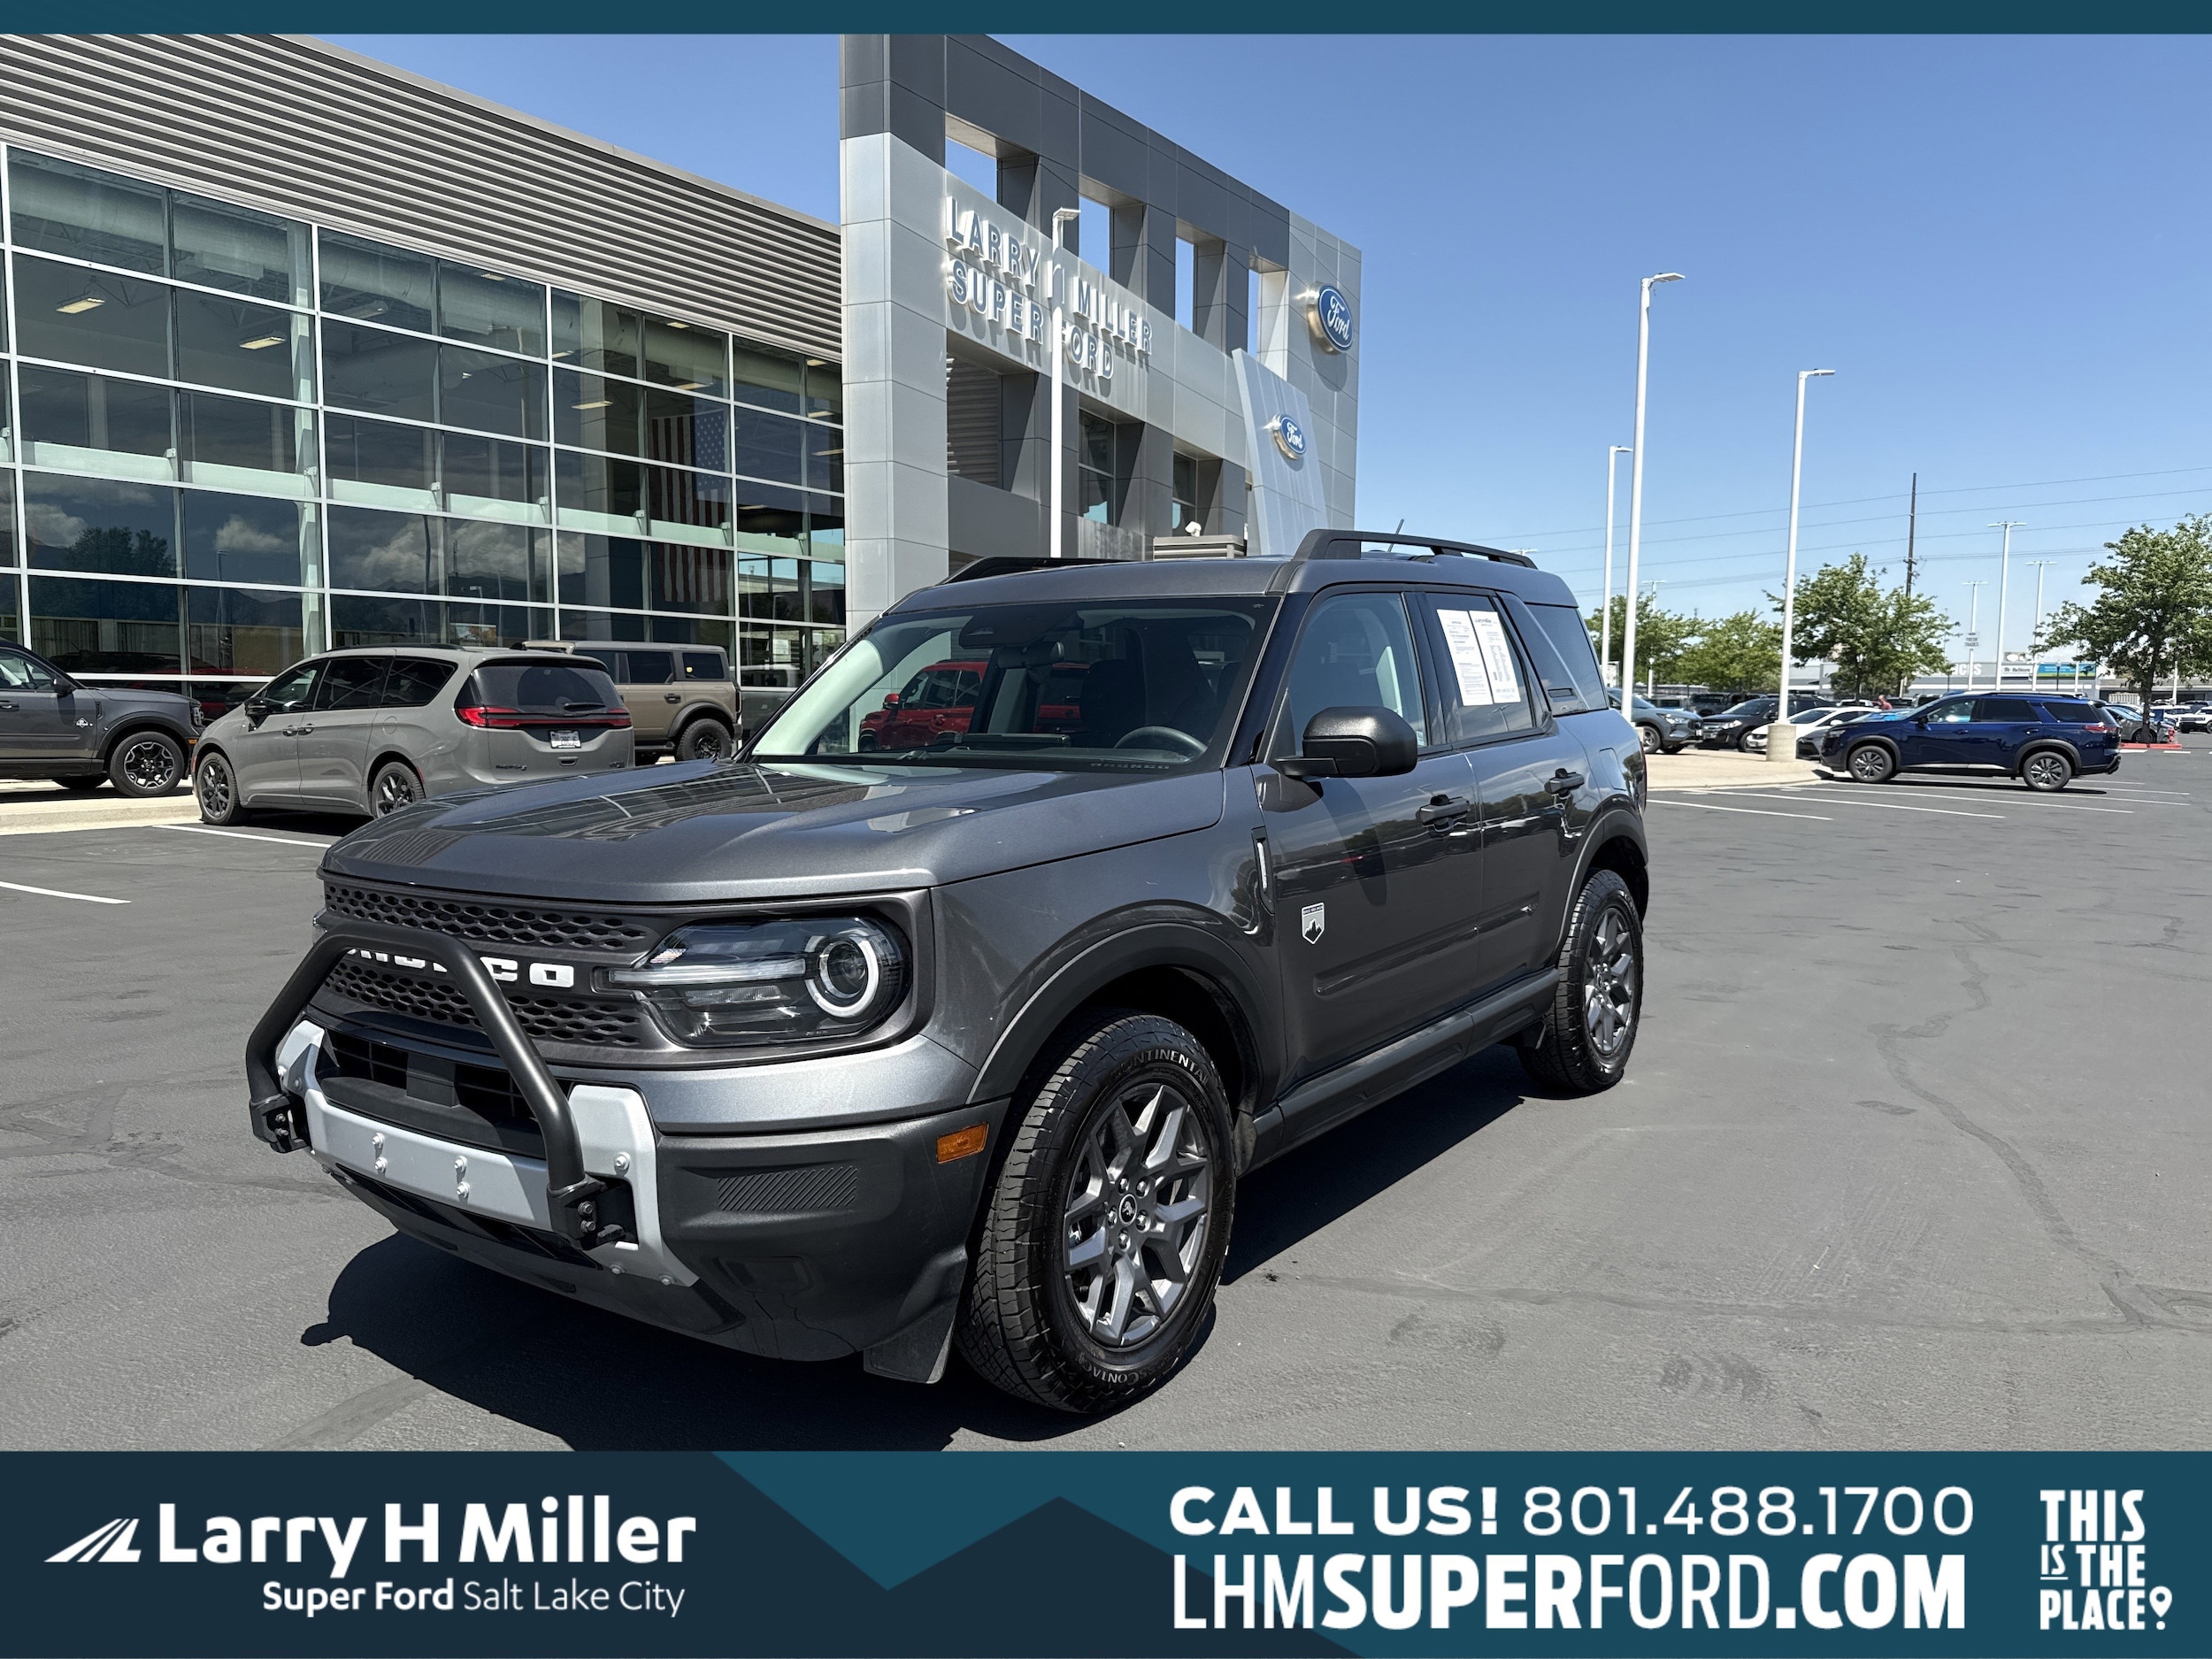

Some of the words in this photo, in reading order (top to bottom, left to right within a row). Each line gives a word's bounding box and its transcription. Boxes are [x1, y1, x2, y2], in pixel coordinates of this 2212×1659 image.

[947, 196, 1041, 288] LARRY
[1072, 276, 1152, 355] MILLER
[948, 258, 1044, 345] SUPER
[1062, 319, 1114, 380] ORD
[1327, 296, 1350, 342] Ford
[1286, 421, 1303, 449] Ford
